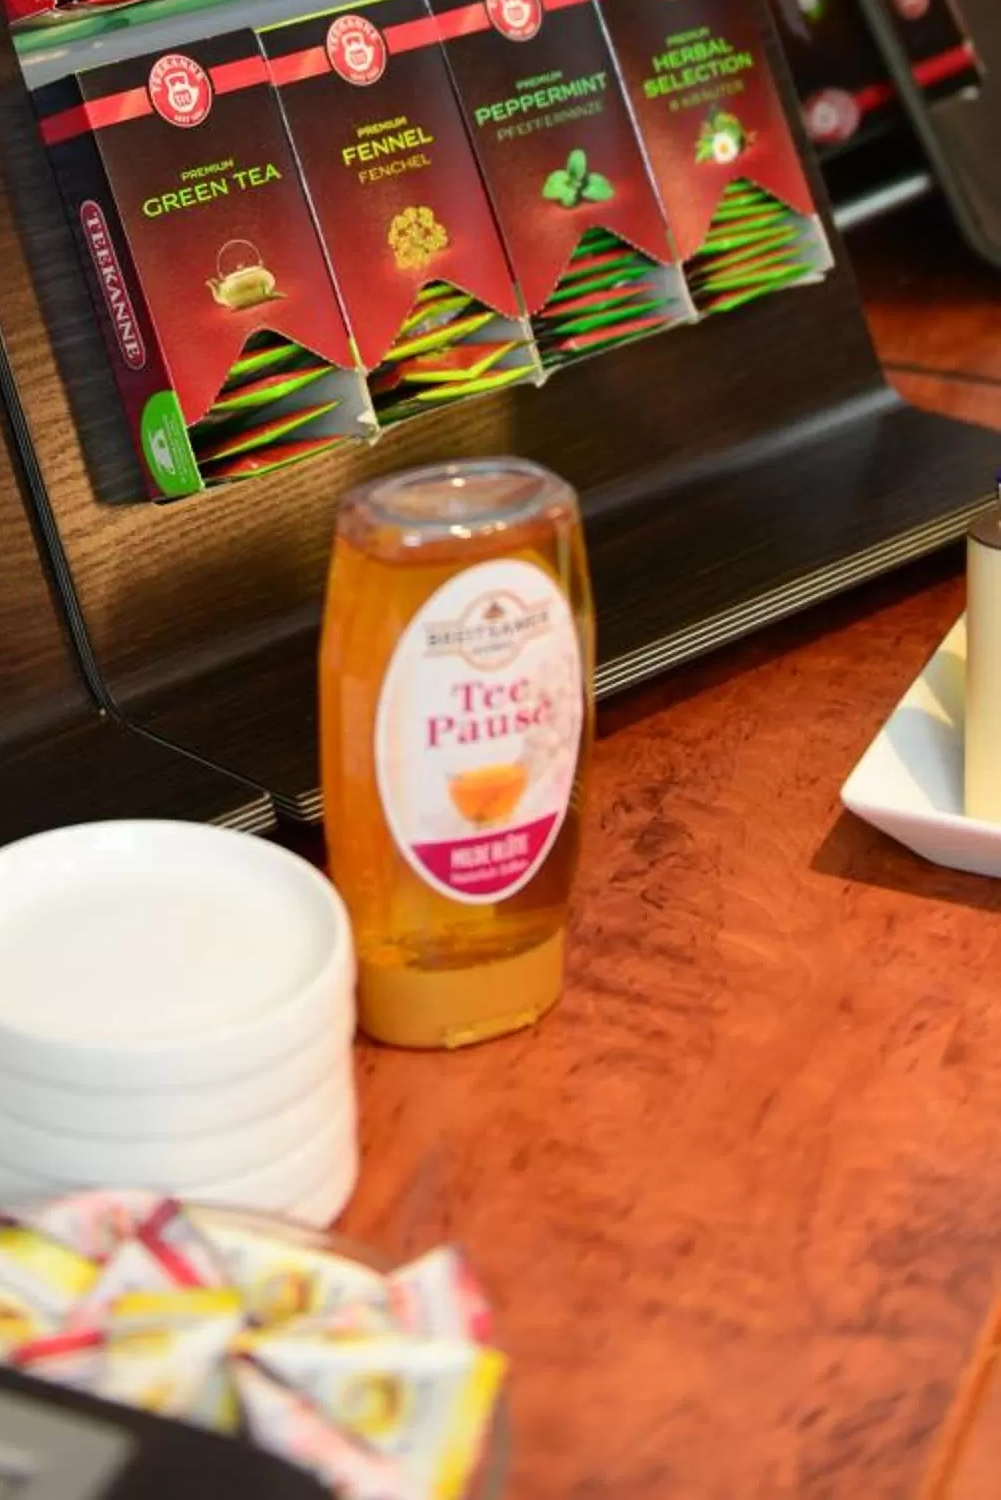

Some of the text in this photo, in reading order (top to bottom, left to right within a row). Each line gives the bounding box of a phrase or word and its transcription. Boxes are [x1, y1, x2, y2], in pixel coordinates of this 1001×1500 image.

[652, 37, 734, 73] HERBAL
[644, 52, 752, 98] SELECTION
[474, 71, 607, 127] PEPPERMINT
[357, 116, 407, 138] PREMIUM
[342, 128, 433, 166] FENNEL
[180, 158, 235, 182] PREMIUM
[358, 153, 432, 184] FENCHEL
[142, 163, 282, 219] GREEN TEA
[86, 211, 141, 357] TEEKANNE
